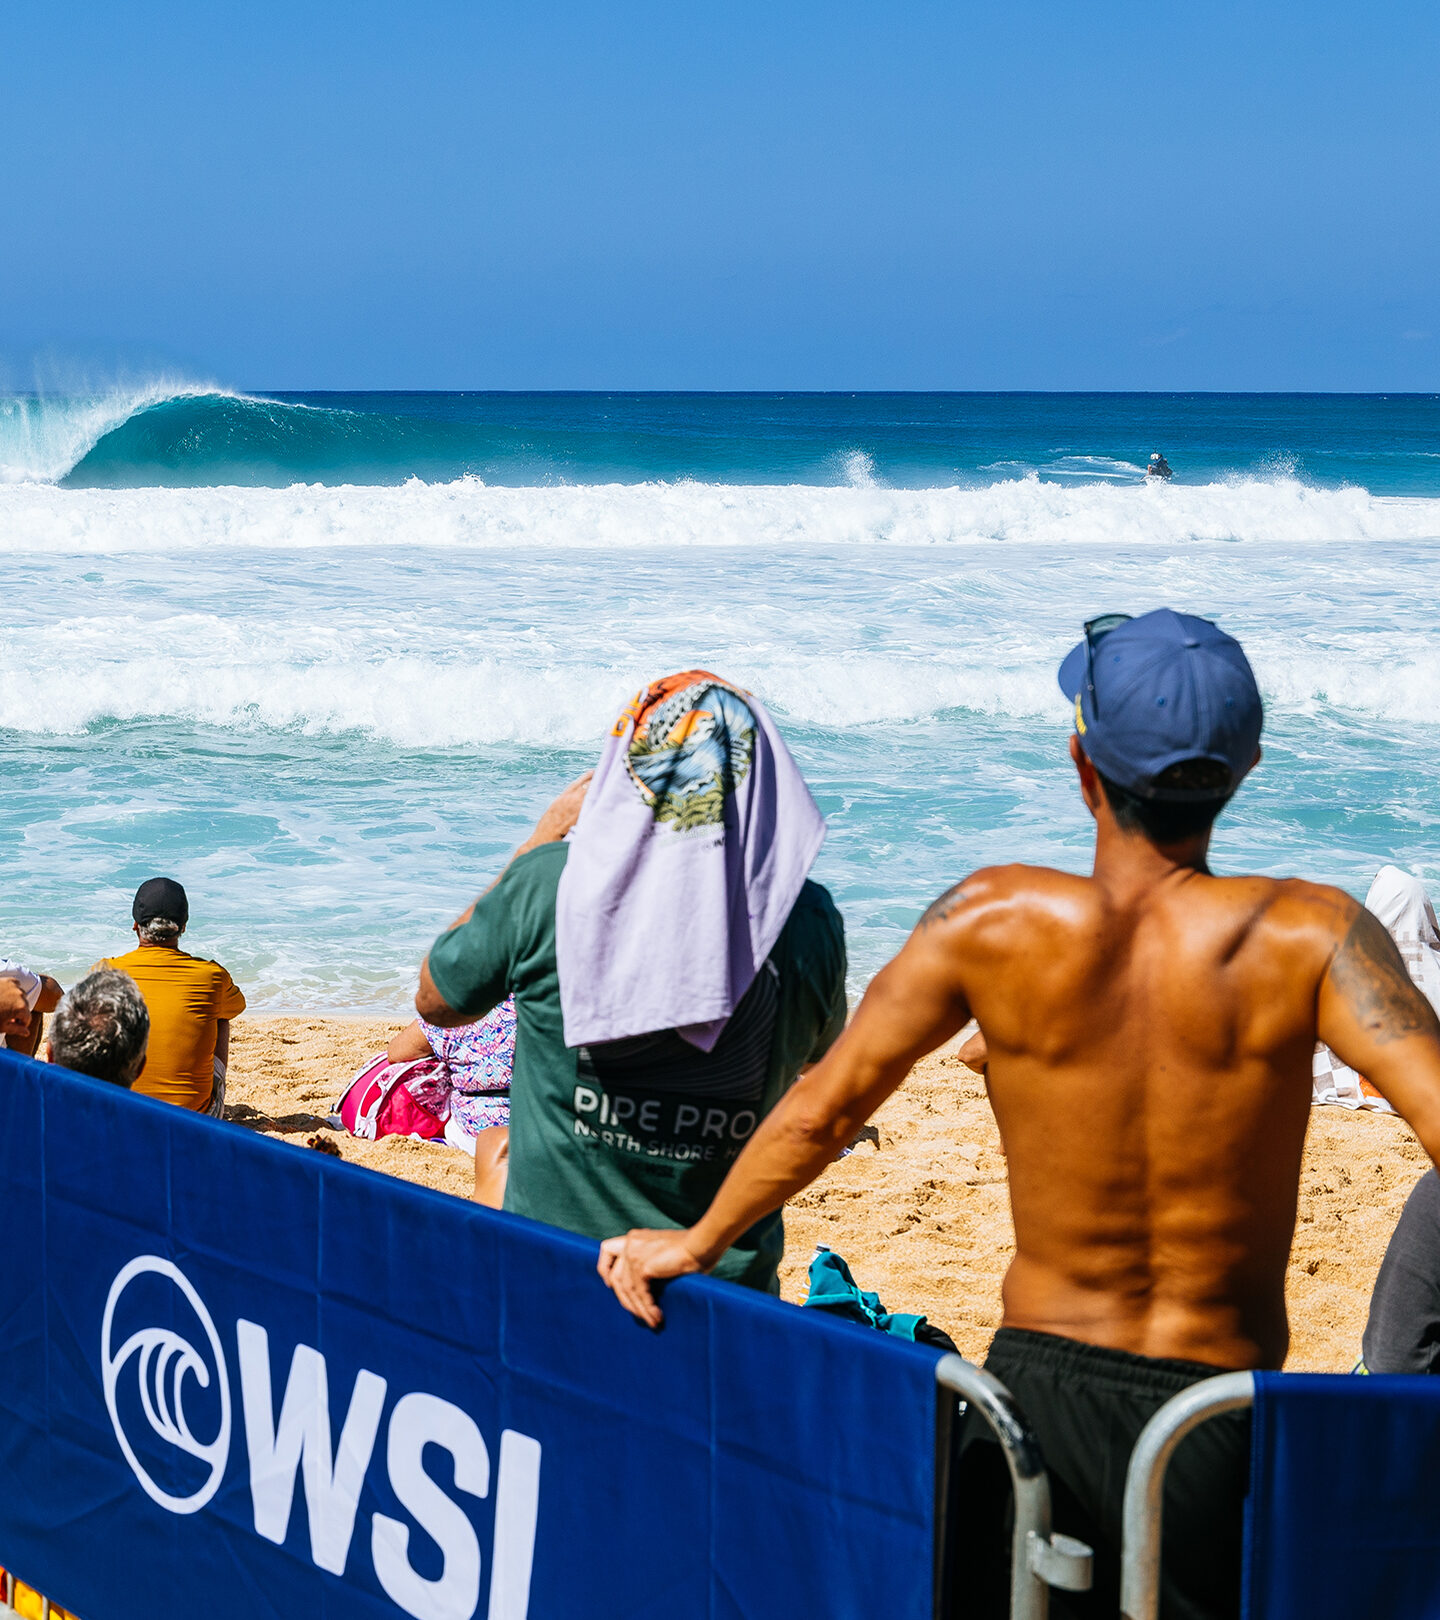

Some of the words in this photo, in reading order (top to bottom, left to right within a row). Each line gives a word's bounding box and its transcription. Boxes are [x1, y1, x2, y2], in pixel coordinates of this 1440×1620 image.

[574, 1086, 661, 1132] PIPE
[674, 1105, 757, 1140] PRO
[647, 1139, 716, 1161] SHORE
